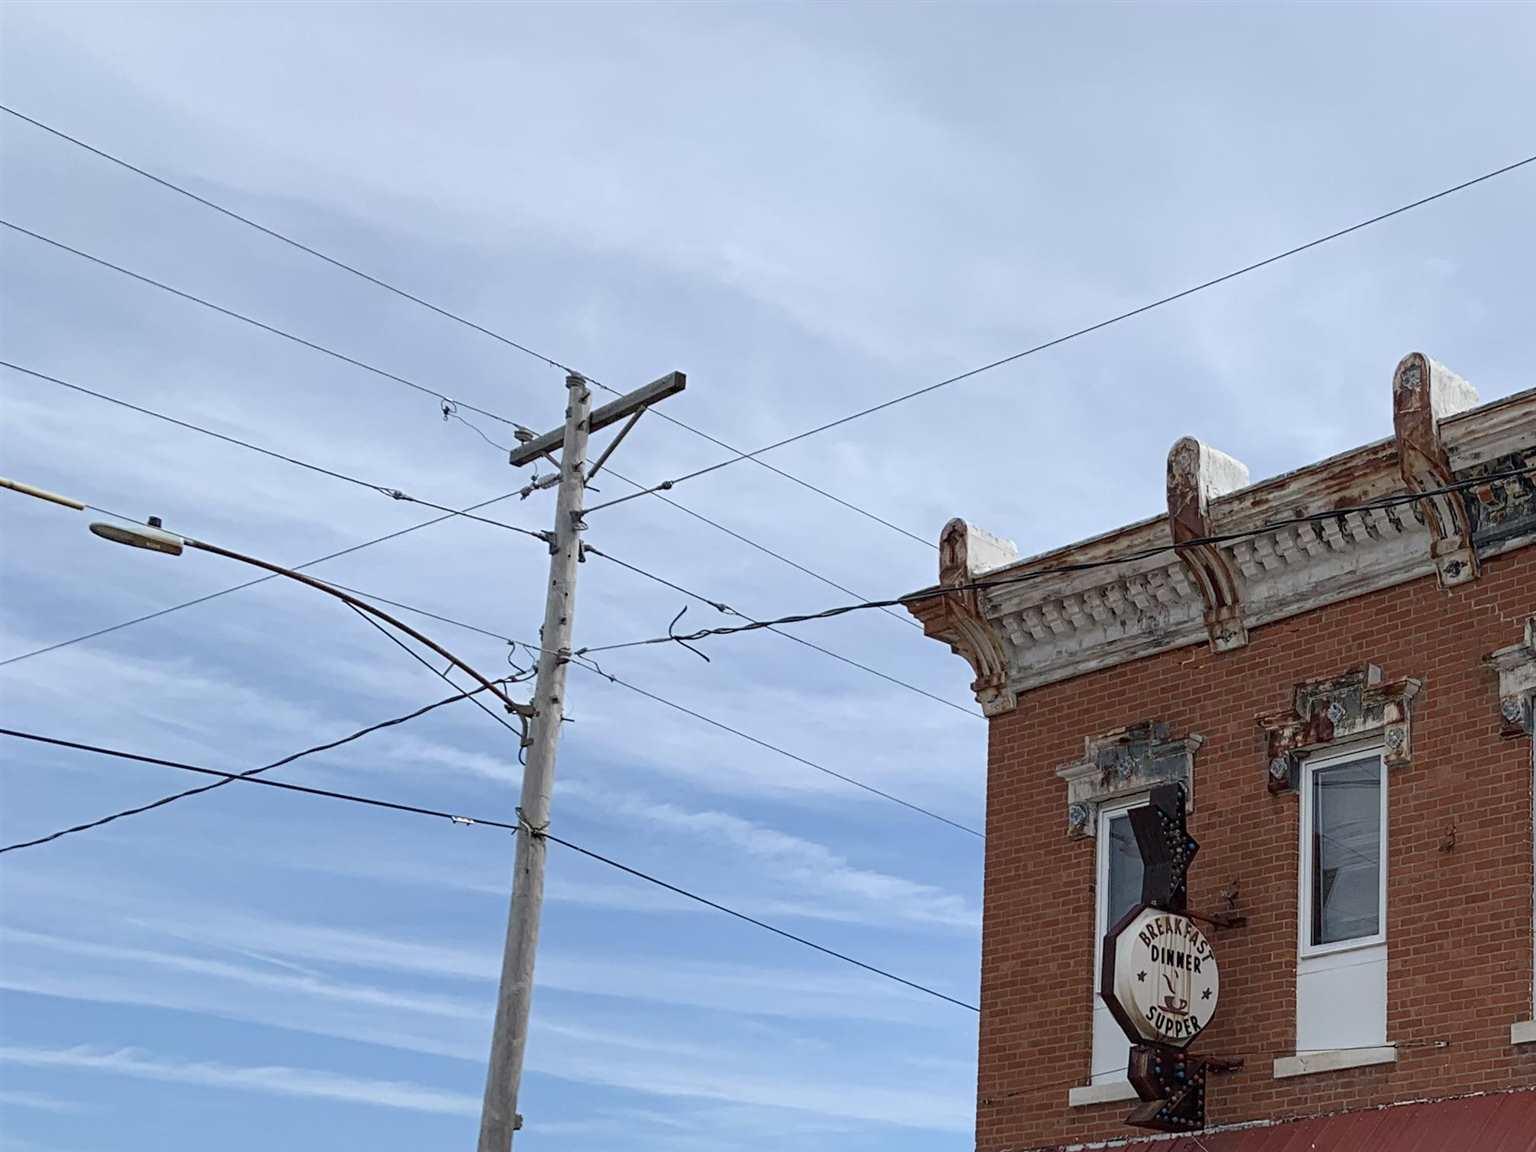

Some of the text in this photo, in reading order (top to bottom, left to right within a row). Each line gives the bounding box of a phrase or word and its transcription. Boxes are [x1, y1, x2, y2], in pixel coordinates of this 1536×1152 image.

[1139, 917, 1214, 962] BREAKFAST
[1151, 945, 1201, 974] DINNER
[1146, 1006, 1201, 1037] SUPPER
